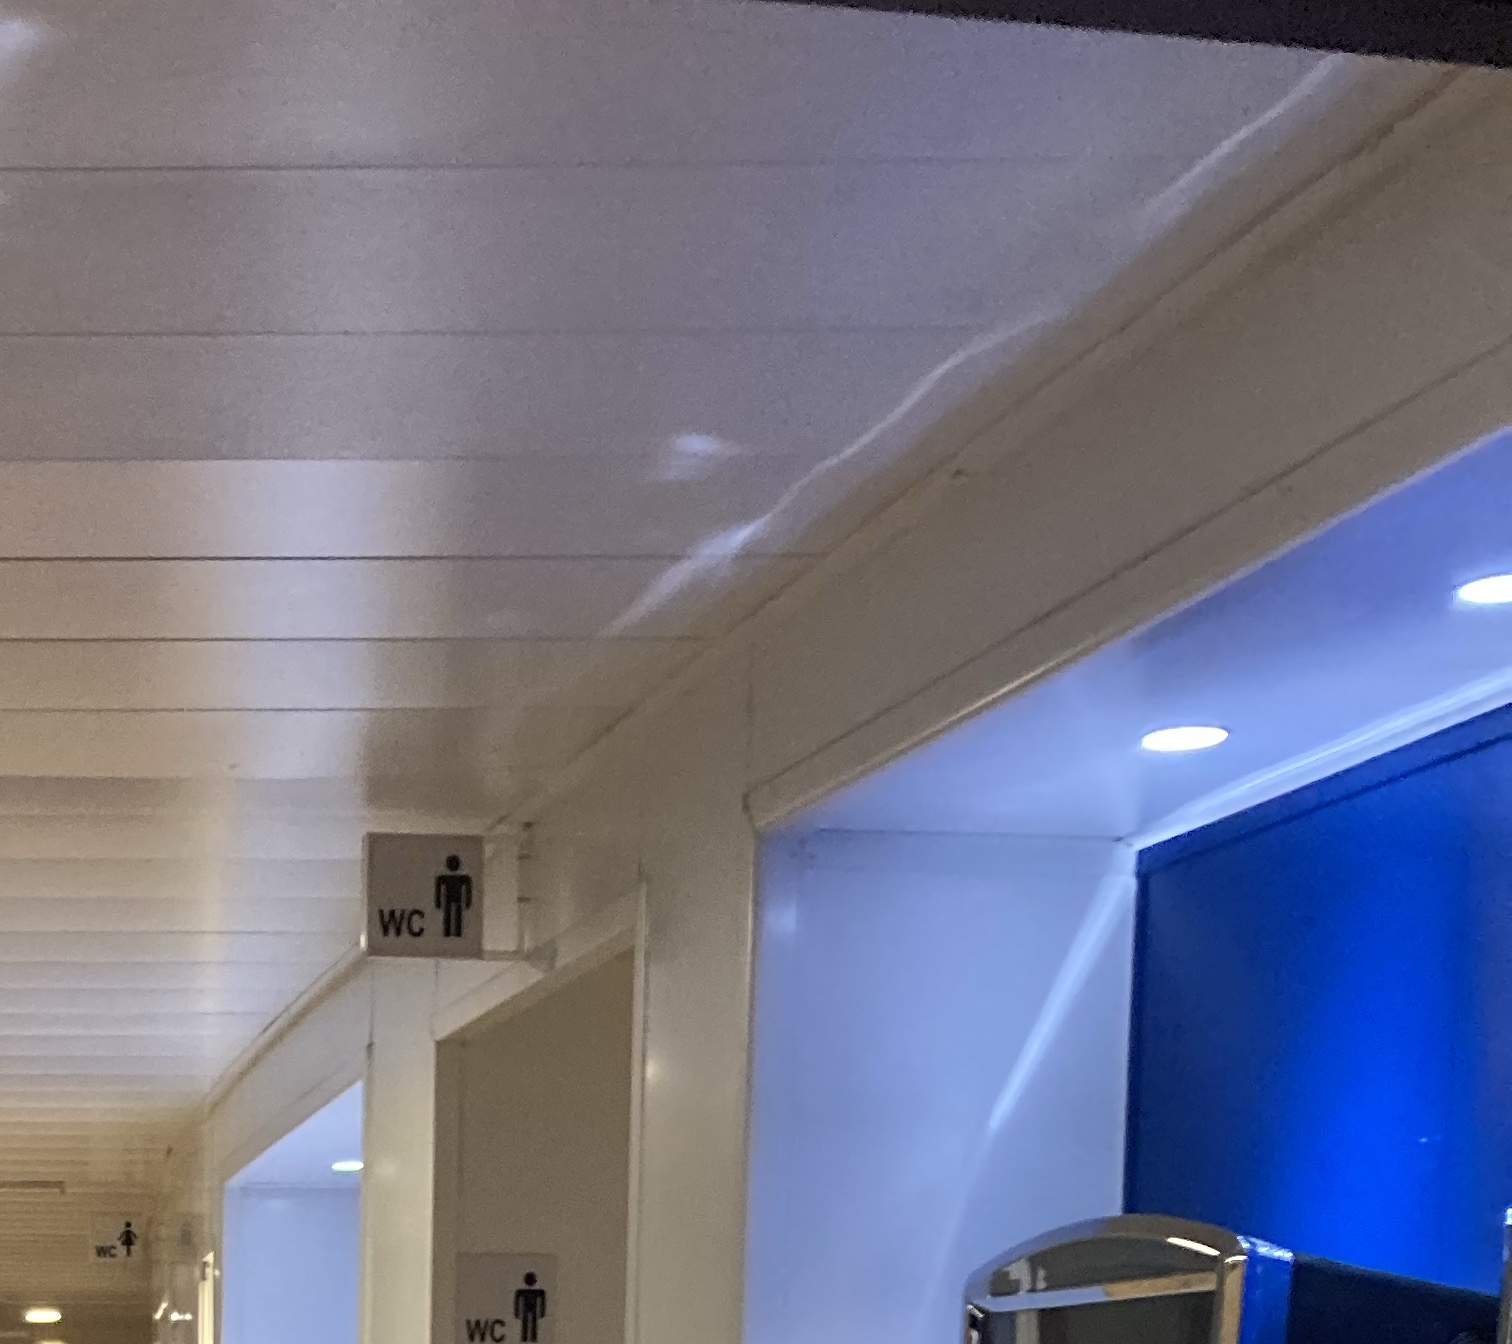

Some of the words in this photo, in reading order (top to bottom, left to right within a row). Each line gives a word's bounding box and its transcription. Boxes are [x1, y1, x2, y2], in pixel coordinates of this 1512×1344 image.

[378, 908, 425, 938] WC
[96, 1245, 117, 1258] WC
[464, 1318, 506, 1344] WC
